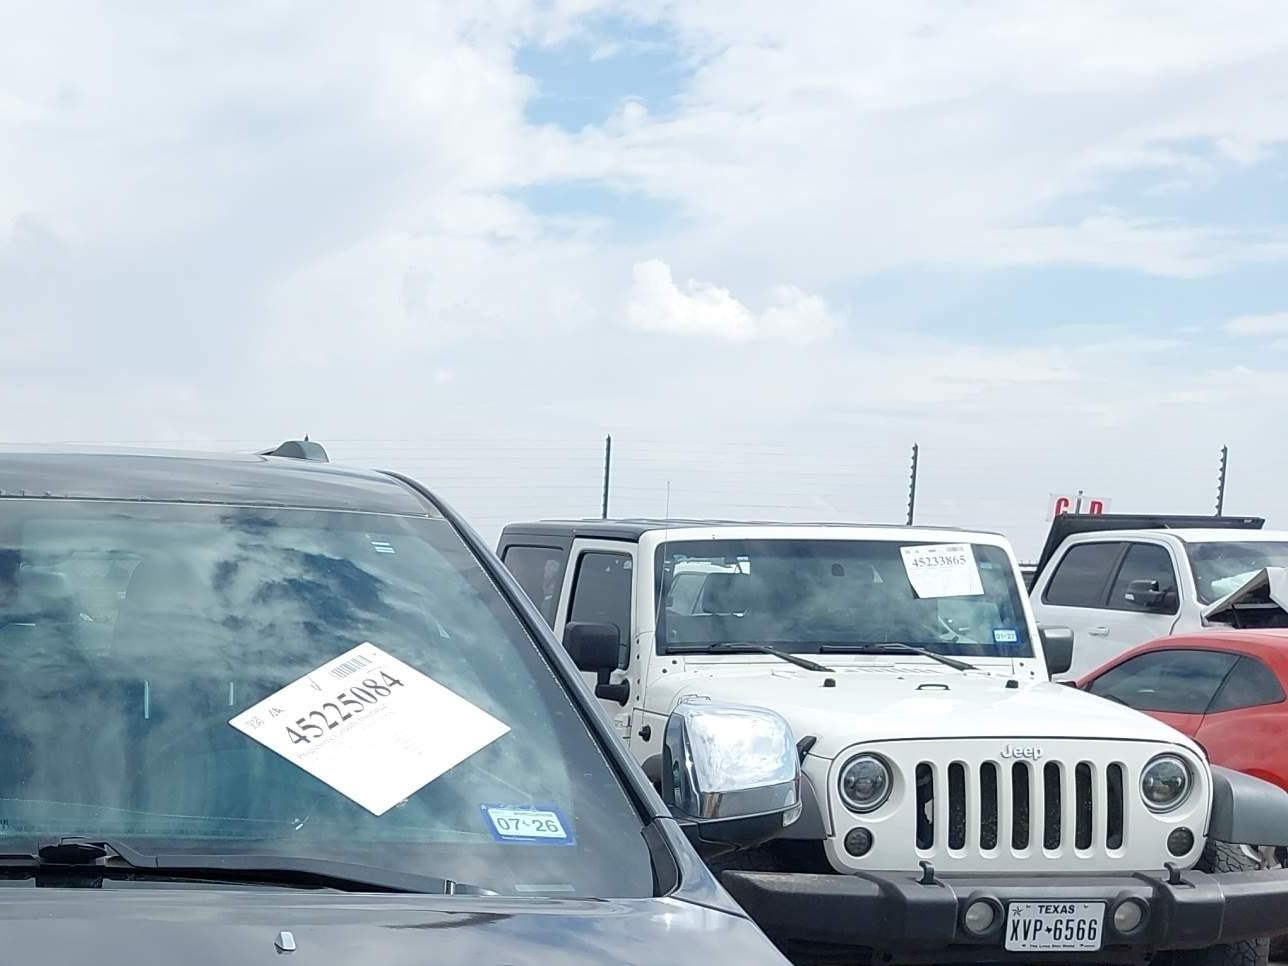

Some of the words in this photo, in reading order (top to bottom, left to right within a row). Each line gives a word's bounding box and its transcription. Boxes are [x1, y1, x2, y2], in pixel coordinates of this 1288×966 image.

[912, 555, 967, 567] 45233865
[285, 671, 404, 744] 45225084
[1000, 744, 1043, 761] Jeep
[1038, 905, 1075, 914] TEXAS
